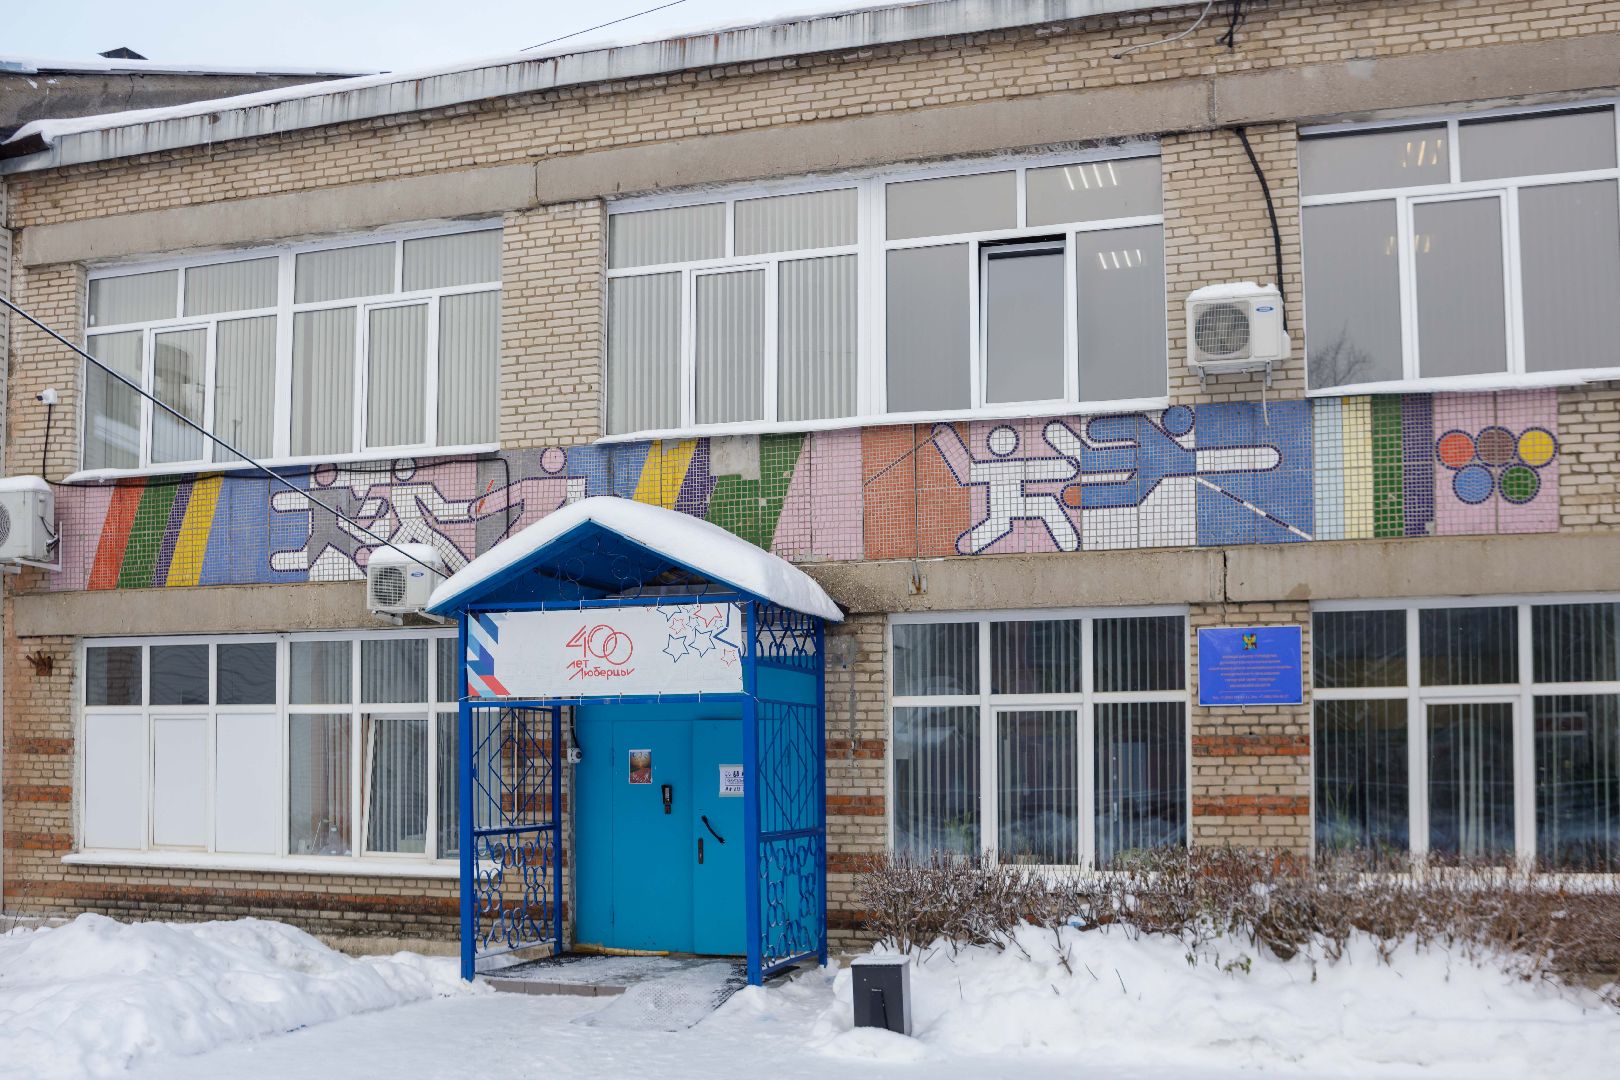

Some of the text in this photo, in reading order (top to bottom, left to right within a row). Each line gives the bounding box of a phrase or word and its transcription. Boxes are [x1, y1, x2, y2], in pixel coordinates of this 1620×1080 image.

[566, 624, 633, 665] 400
[566, 660, 589, 669] лет
[569, 667, 635, 680] Люберцы
